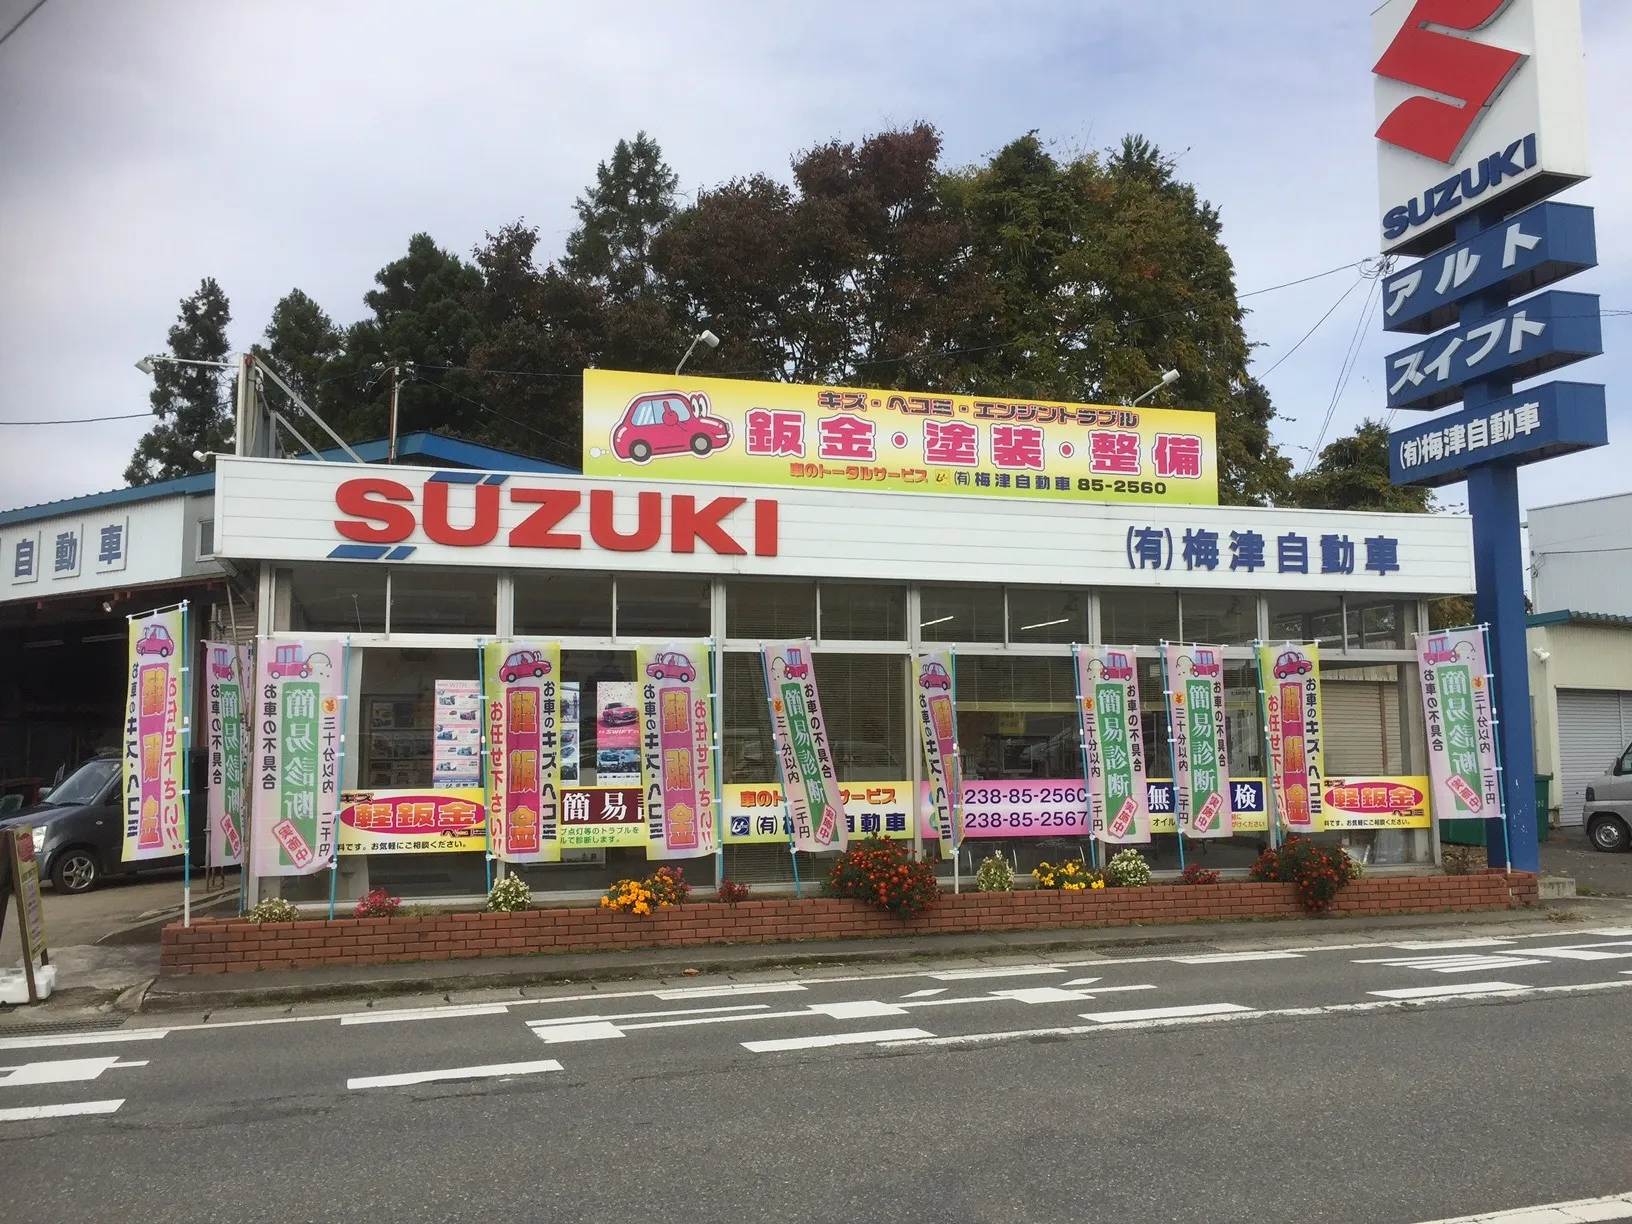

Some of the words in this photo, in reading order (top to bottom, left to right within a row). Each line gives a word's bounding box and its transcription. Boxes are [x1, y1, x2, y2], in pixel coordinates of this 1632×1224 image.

[1383, 133, 1537, 240] SUZUKI
[1386, 222, 1543, 317] アルト
[1389, 310, 1546, 395] スイフト
[745, 407, 1202, 479] 鈑金・塗装・整備
[818, 390, 1140, 428] キズ・ヘコミ・エンジントラブル
[1400, 401, 1541, 469] (有)梅津自動車
[789, 462, 929, 484] 車のトータルサービス
[1077, 478, 1167, 495] 85-2560
[14, 524, 123, 578] 自動車
[334, 478, 778, 557] SUZUKI
[1127, 525, 1400, 576] (有)梅津自動車
[804, 683, 832, 779] お車の不具合
[1098, 689, 1129, 798] 簡易診断
[1126, 685, 1142, 772] お車の不具合
[1189, 685, 1216, 793] 簡易診断
[1213, 681, 1226, 767] お車の不具合
[353, 802, 476, 828] 軽鈑金
[964, 788, 1087, 805] 238-85-2560
[964, 811, 1088, 828] 238-85-2567
[1333, 787, 1415, 809] 軽鈑金
